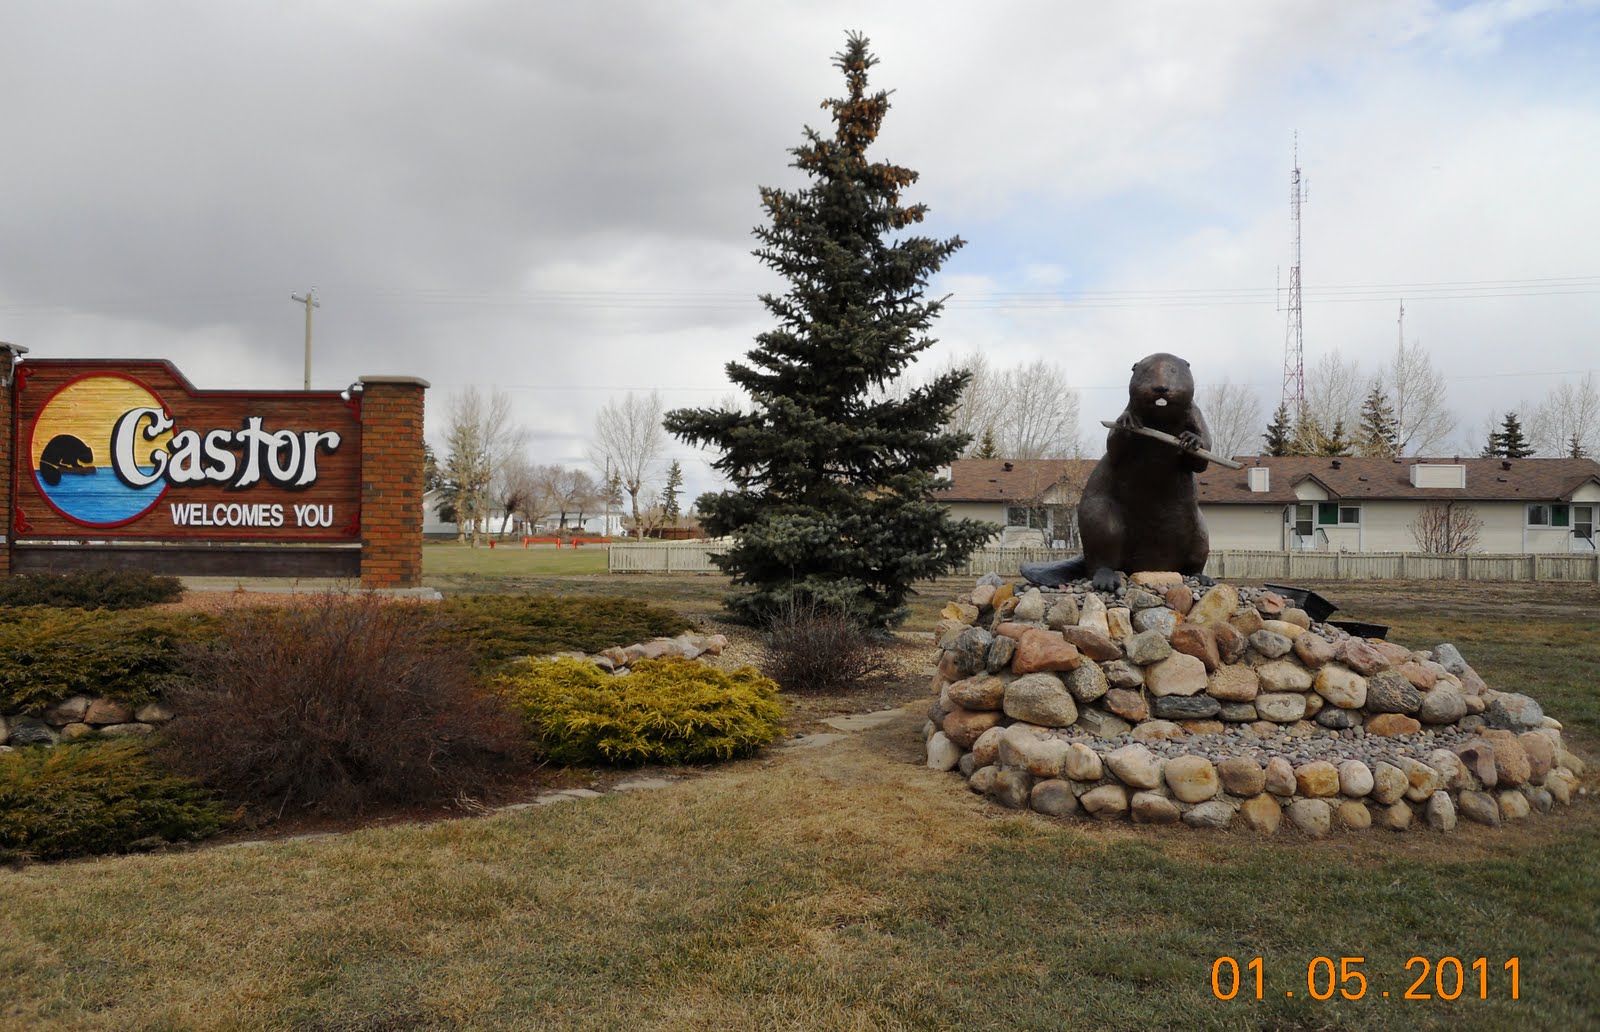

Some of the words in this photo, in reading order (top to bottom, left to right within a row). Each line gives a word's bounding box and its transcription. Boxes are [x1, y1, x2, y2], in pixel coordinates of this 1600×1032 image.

[113, 406, 341, 488] Castor
[170, 503, 284, 527] WELCOMES
[294, 504, 334, 528] YOU
